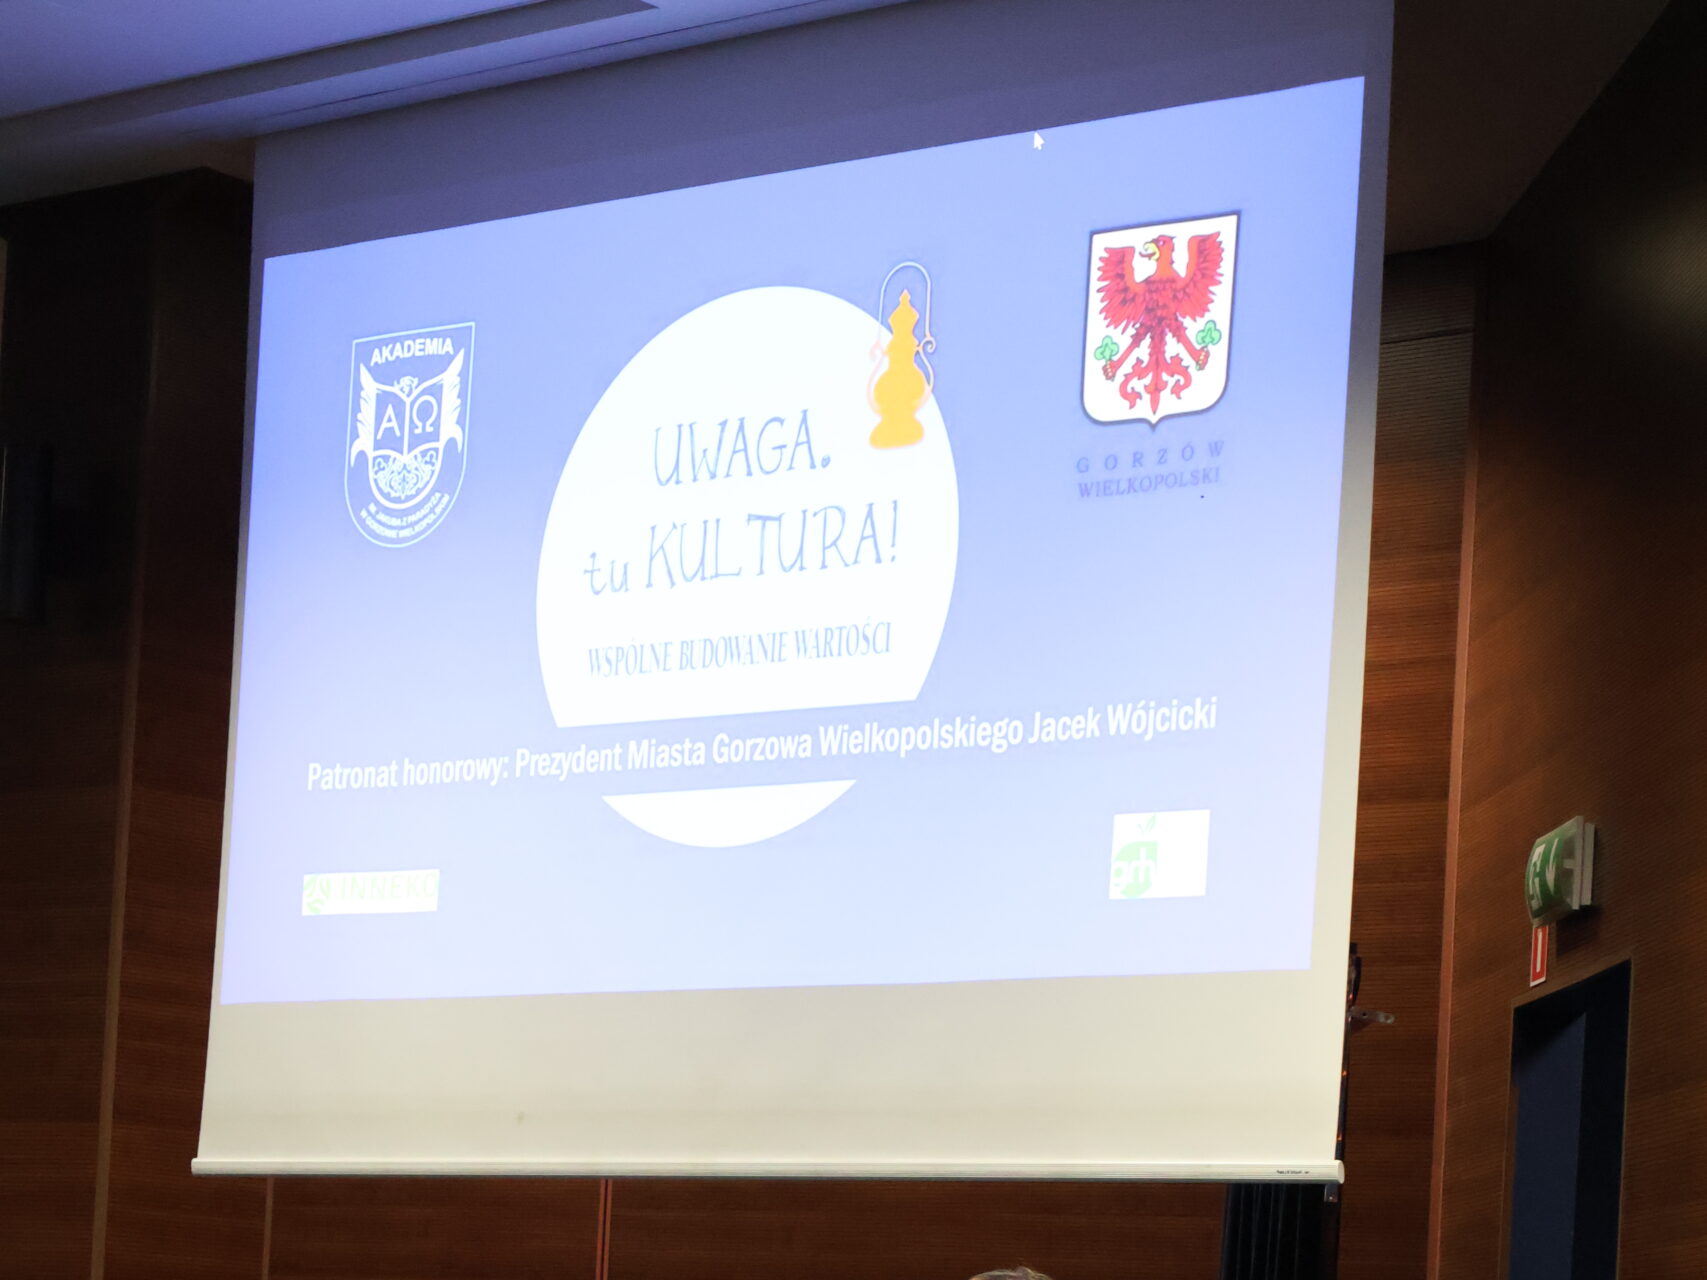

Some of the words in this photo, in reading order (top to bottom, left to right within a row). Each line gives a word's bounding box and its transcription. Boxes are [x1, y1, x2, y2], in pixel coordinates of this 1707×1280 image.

[370, 337, 454, 367] AKADEMIA
[1078, 468, 1221, 498] WIELKOPOLSKI
[584, 552, 629, 596] tu
[646, 499, 898, 589] KULTURA!
[679, 631, 788, 671] BUDOWANIE
[794, 616, 893, 661] WARTOŚCI
[307, 757, 398, 791] Patronat
[402, 754, 509, 786] honorowy:
[515, 742, 622, 781] Prezydent
[627, 737, 706, 770] Miasta
[712, 732, 812, 764] Gorzowa
[818, 715, 1023, 758] Wielkopolskiego
[1028, 705, 1101, 744] Jacek
[1107, 696, 1218, 742] Wójcicki
